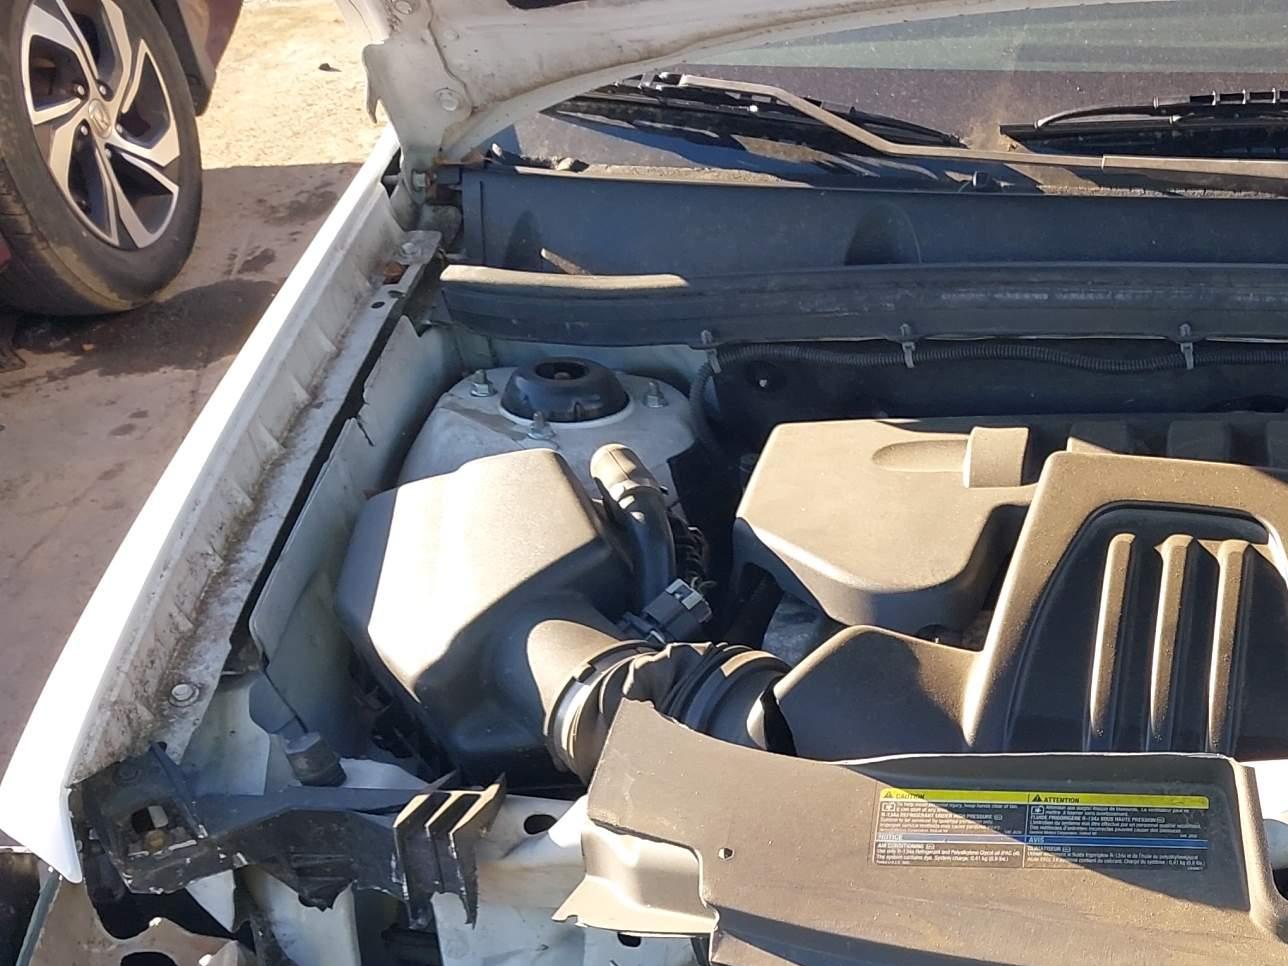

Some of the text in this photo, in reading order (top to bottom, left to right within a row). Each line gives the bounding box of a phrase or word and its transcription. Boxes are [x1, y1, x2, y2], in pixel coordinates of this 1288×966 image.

[895, 792, 926, 800] CAUTION
[1043, 796, 1080, 804] ATTENTION
[877, 832, 903, 841] NOTICE
[1028, 836, 1045, 844] AVIS
